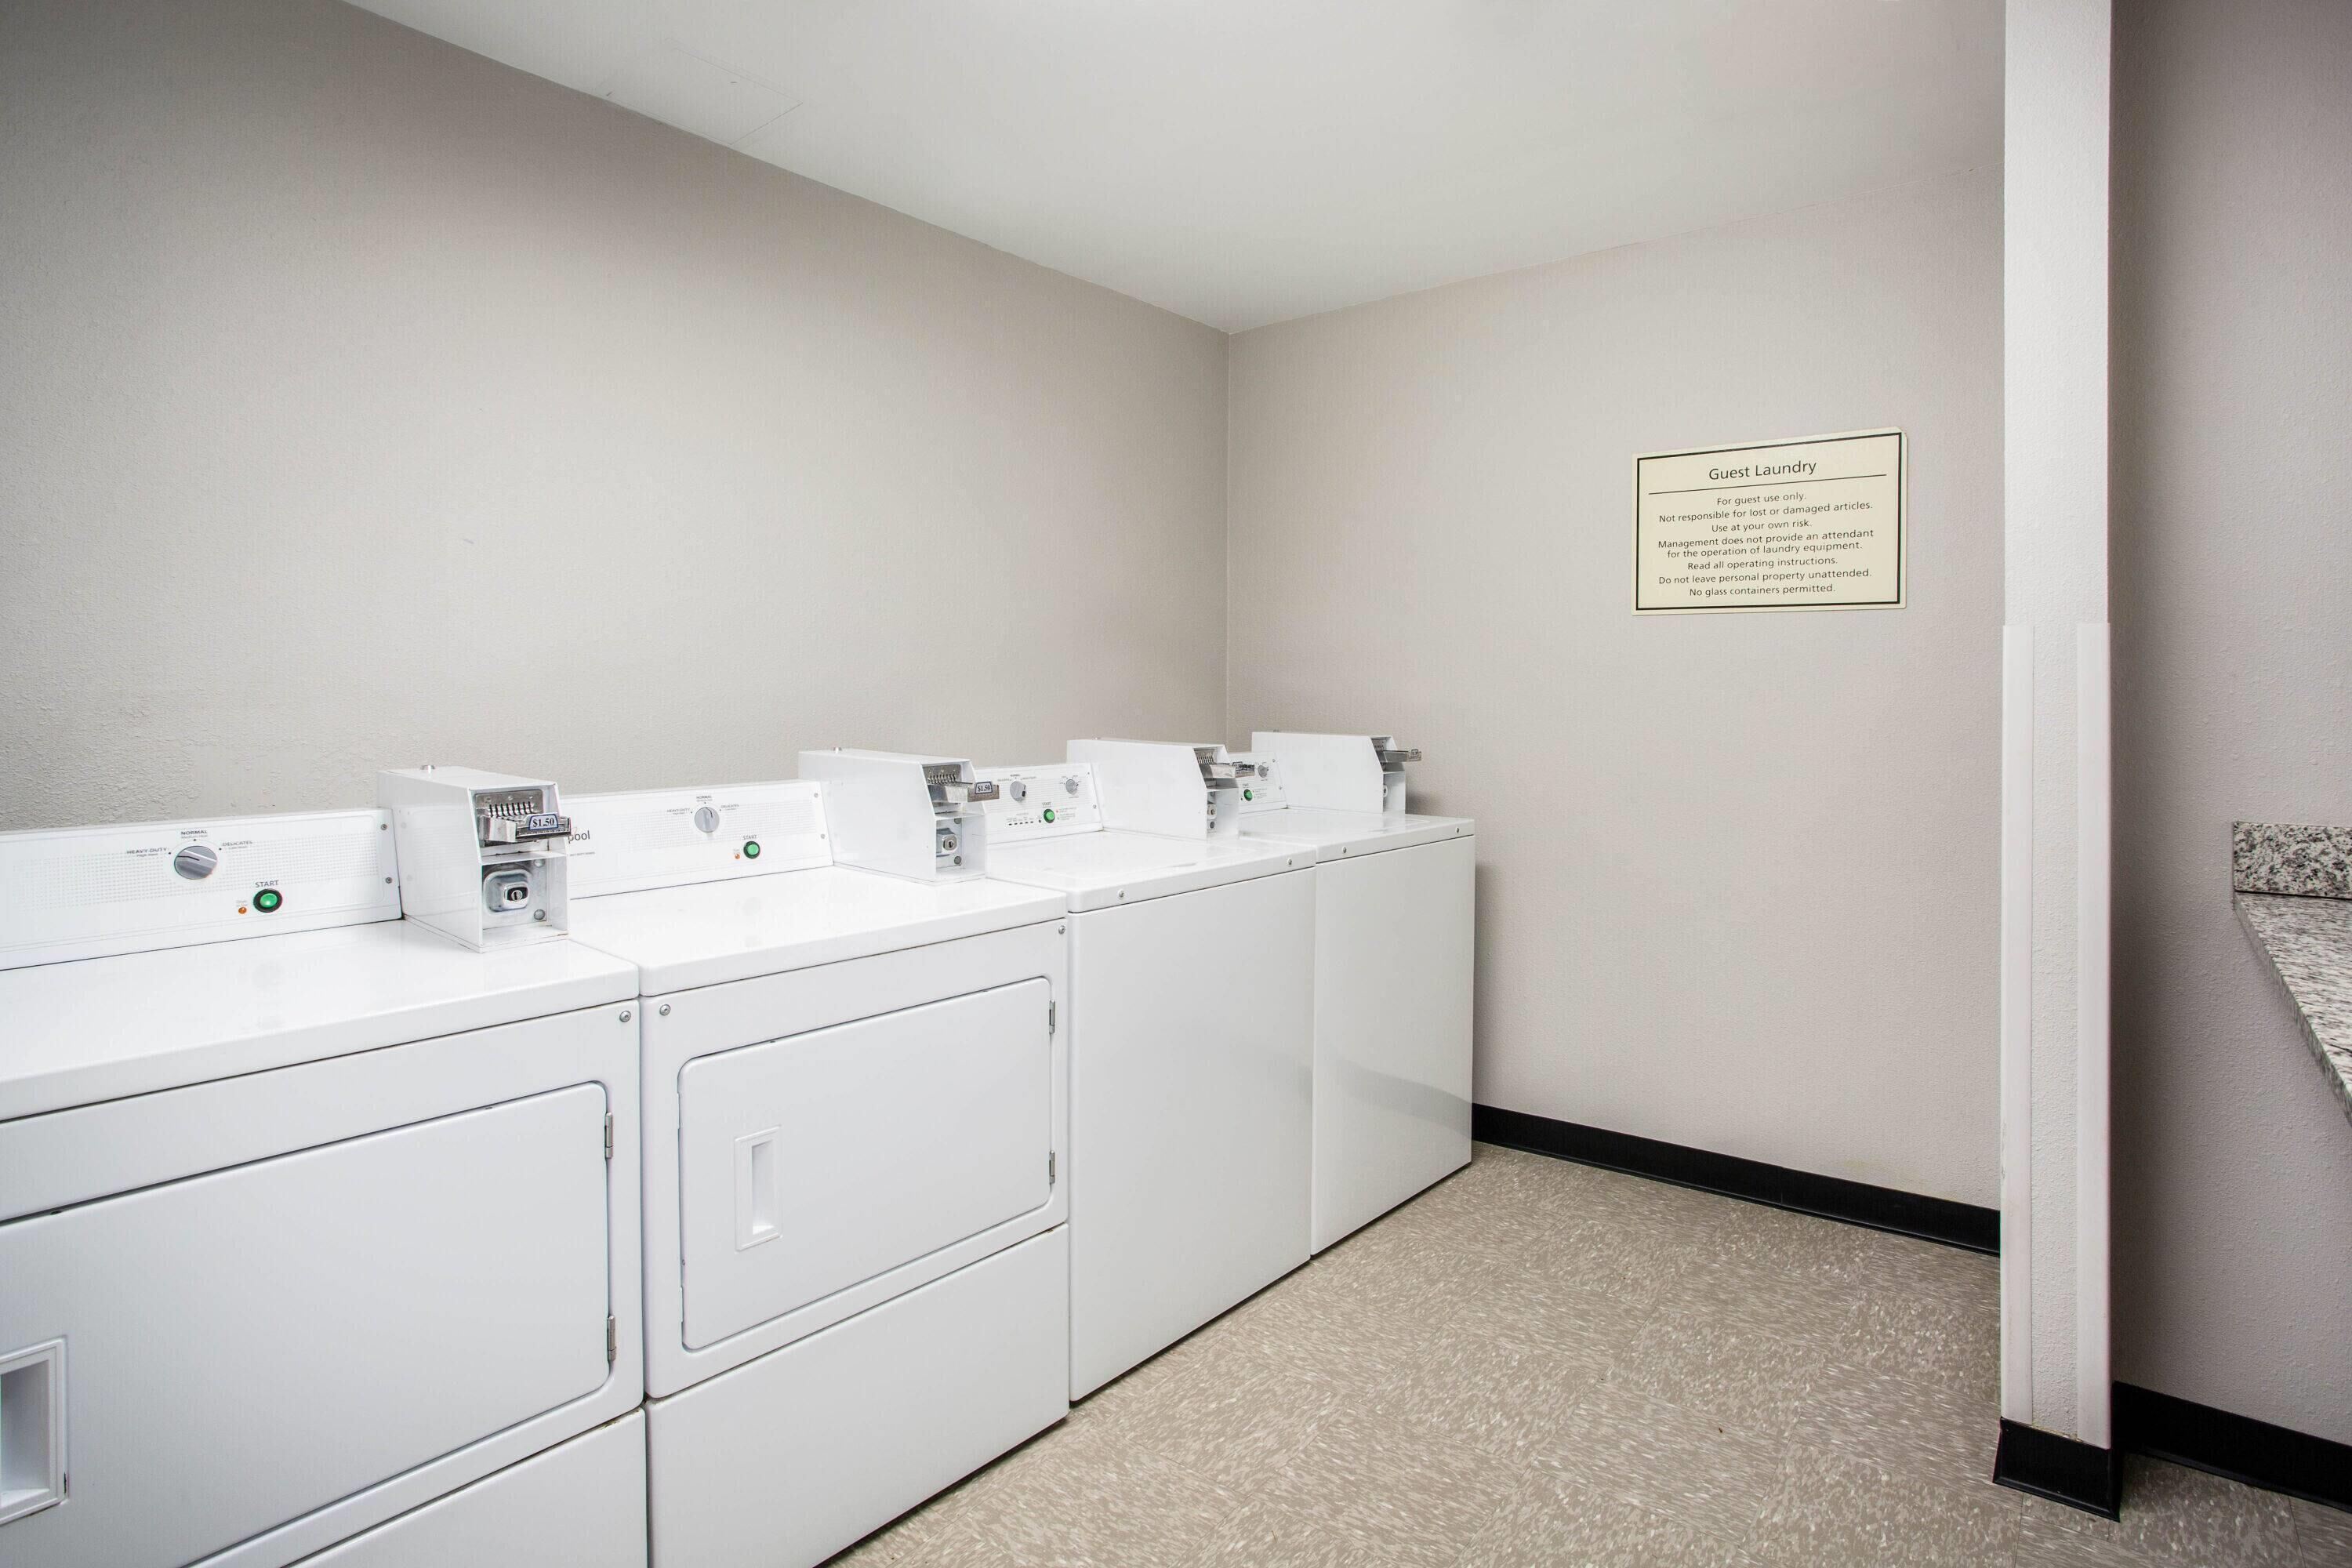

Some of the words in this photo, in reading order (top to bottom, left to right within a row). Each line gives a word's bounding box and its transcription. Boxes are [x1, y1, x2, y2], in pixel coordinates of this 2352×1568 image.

[1708, 466, 1751, 481] Guest
[1755, 460, 1817, 477] Laundry
[1734, 495, 1760, 506] guest
[1783, 492, 1806, 502] only.
[1659, 514, 1675, 523] Not
[1678, 510, 1730, 522] responsible
[1733, 509, 1747, 518] for
[1750, 508, 1766, 517] lost
[1783, 503, 1831, 515] damaged
[1833, 501, 1873, 511] articles.
[1792, 519, 1813, 528] risk.
[1658, 538, 1719, 550] Management
[1721, 537, 1744, 546] does
[1766, 532, 1803, 545] provide
[1821, 529, 1874, 540] attendant
[1667, 550, 1680, 558] for
[1700, 546, 1747, 558] operation
[1749, 545, 1760, 554] of
[1763, 544, 1801, 554] laundry
[1803, 541, 1863, 553] equipment.
[1687, 561, 1711, 570] Read
[1713, 561, 1724, 569] all
[1726, 560, 1774, 570] operating
[1777, 557, 1838, 566] instructions.
[1692, 575, 1716, 583] leave
[1719, 572, 1759, 584] personal
[1762, 572, 1806, 583] property
[1808, 568, 1871, 579] unattended.
[1690, 588, 1703, 597] No
[1704, 587, 1727, 598] glass
[1783, 583, 1835, 595] permitted.
[532, 818, 554, 827] $1.50
